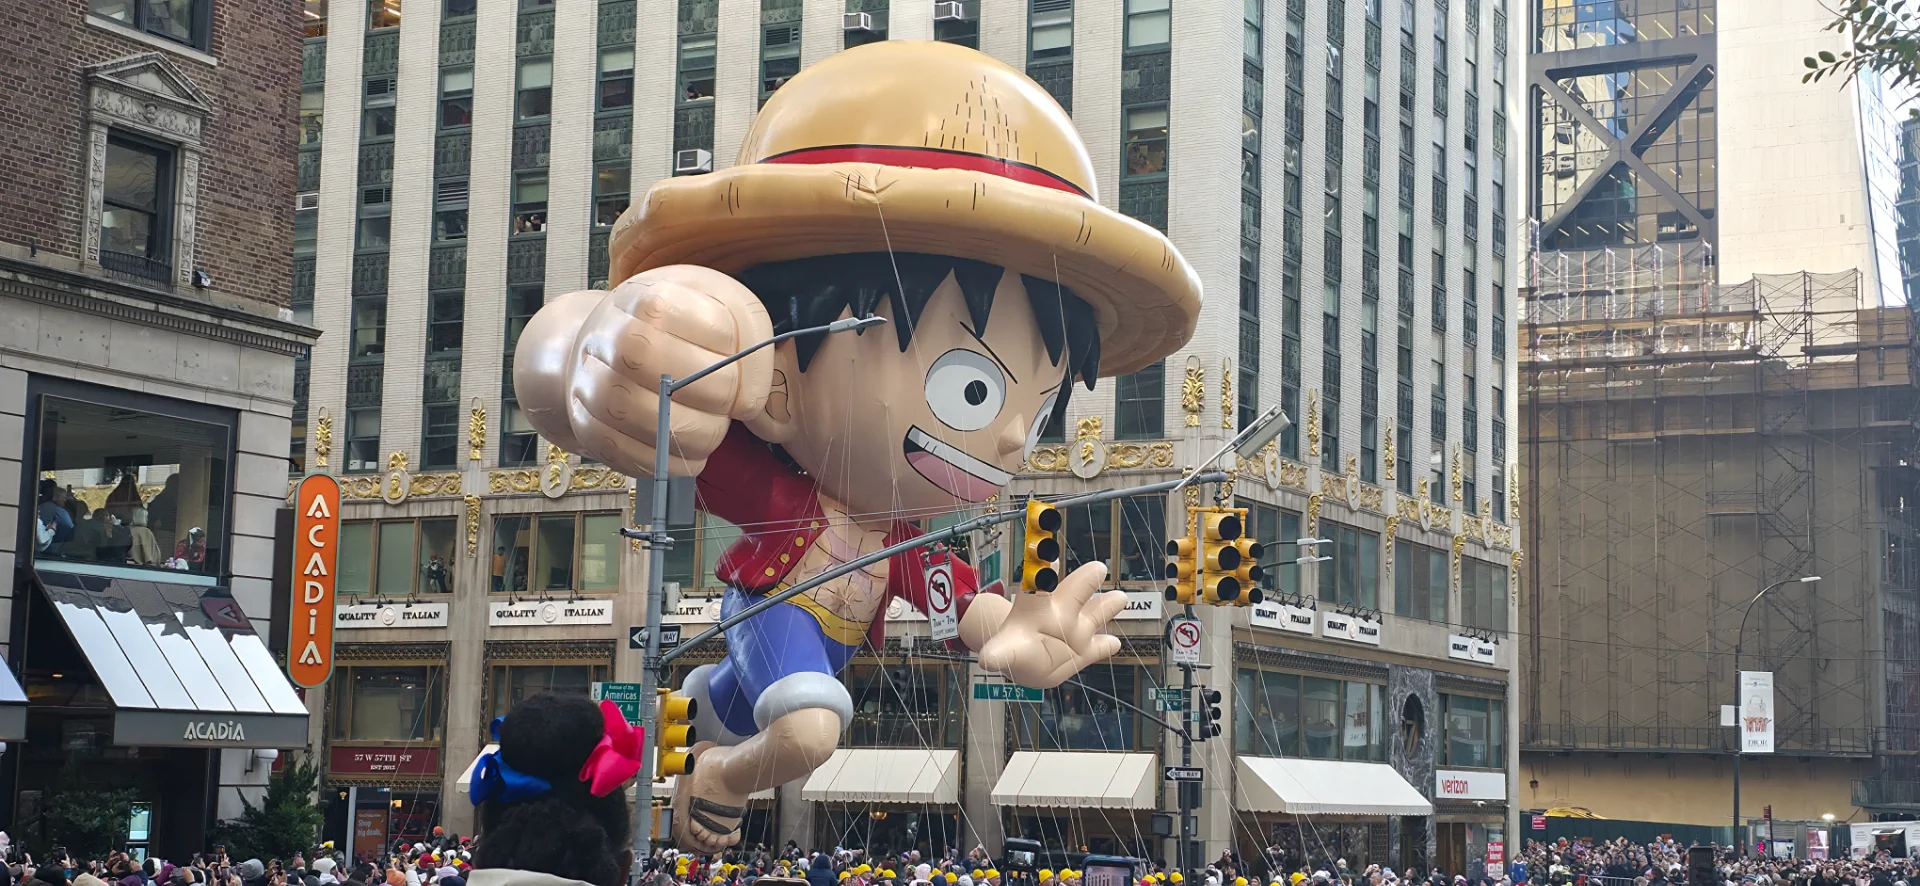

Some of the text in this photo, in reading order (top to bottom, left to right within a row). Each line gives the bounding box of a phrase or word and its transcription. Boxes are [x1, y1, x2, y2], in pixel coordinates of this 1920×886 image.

[1124, 601, 1152, 610] LIAN
[338, 611, 440, 621] QUALITY ITALIAN
[496, 608, 604, 618] QUALITY ITALIAN
[676, 607, 703, 615] LITY
[1255, 608, 1311, 625] QUALITY ITALIAN
[1327, 620, 1378, 636] QUALITY ITALIAN
[663, 632, 676, 642] WAY
[604, 690, 637, 700] Americas
[992, 686, 1025, 698] W 57 St
[1748, 739, 1768, 748] DIOR
[354, 754, 412, 763] 57 W 57TH ST
[1441, 775, 1469, 794] verizon
